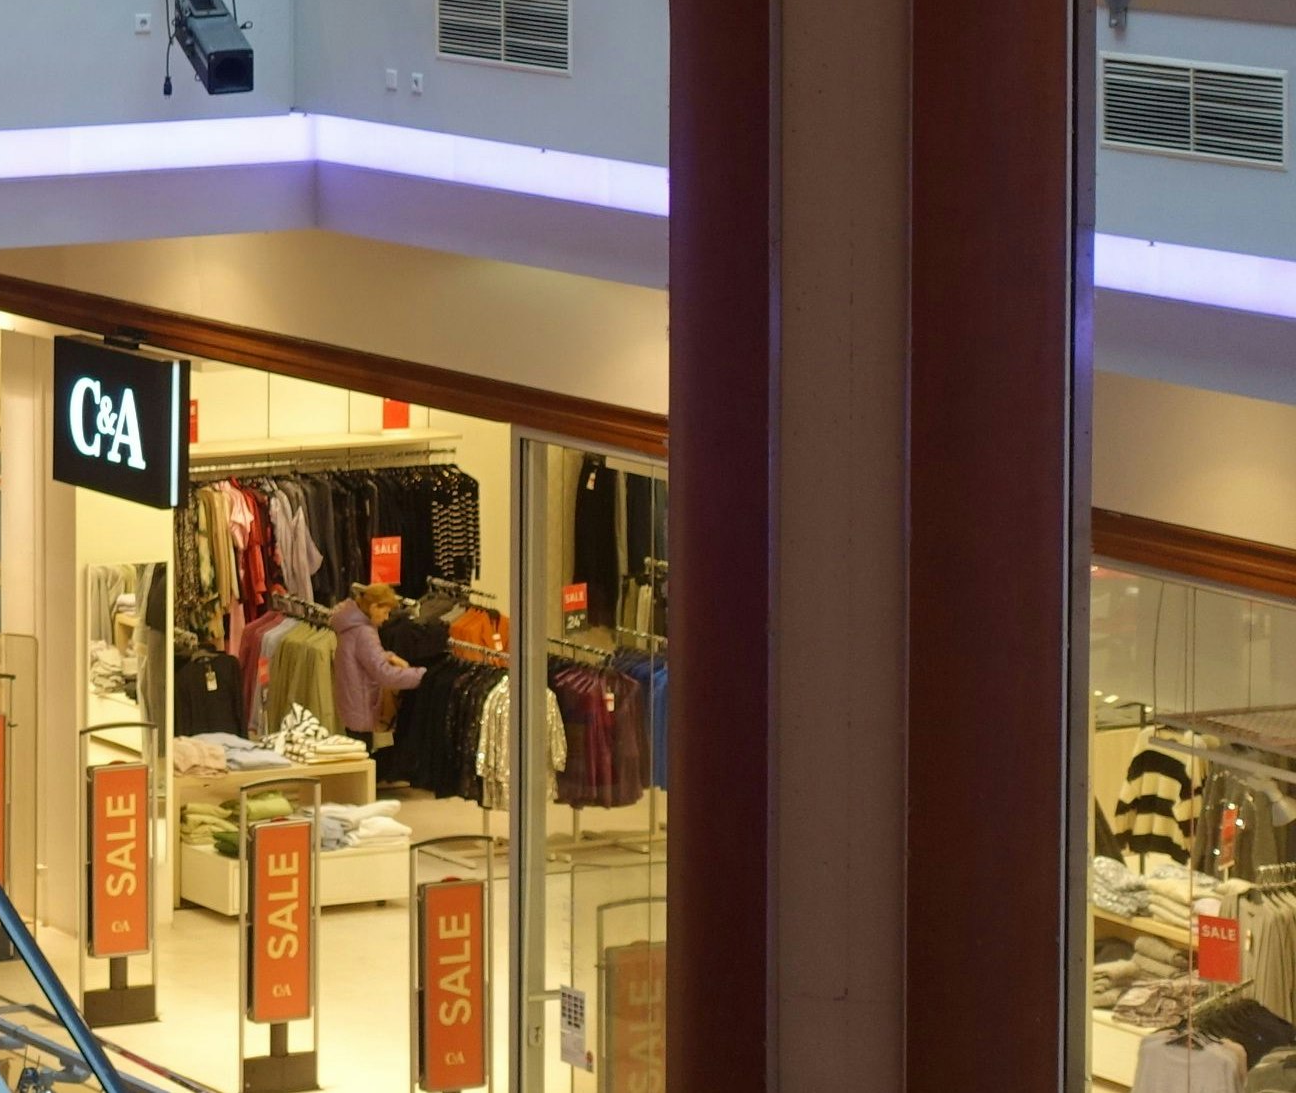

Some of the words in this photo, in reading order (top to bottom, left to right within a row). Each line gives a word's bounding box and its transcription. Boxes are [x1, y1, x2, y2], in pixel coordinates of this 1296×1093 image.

[70, 377, 147, 471] C&A
[373, 542, 400, 556] SALE
[106, 793, 137, 897] SALE
[267, 851, 299, 960] SALE
[1201, 924, 1237, 942] SALE
[438, 912, 472, 1027] SALE
